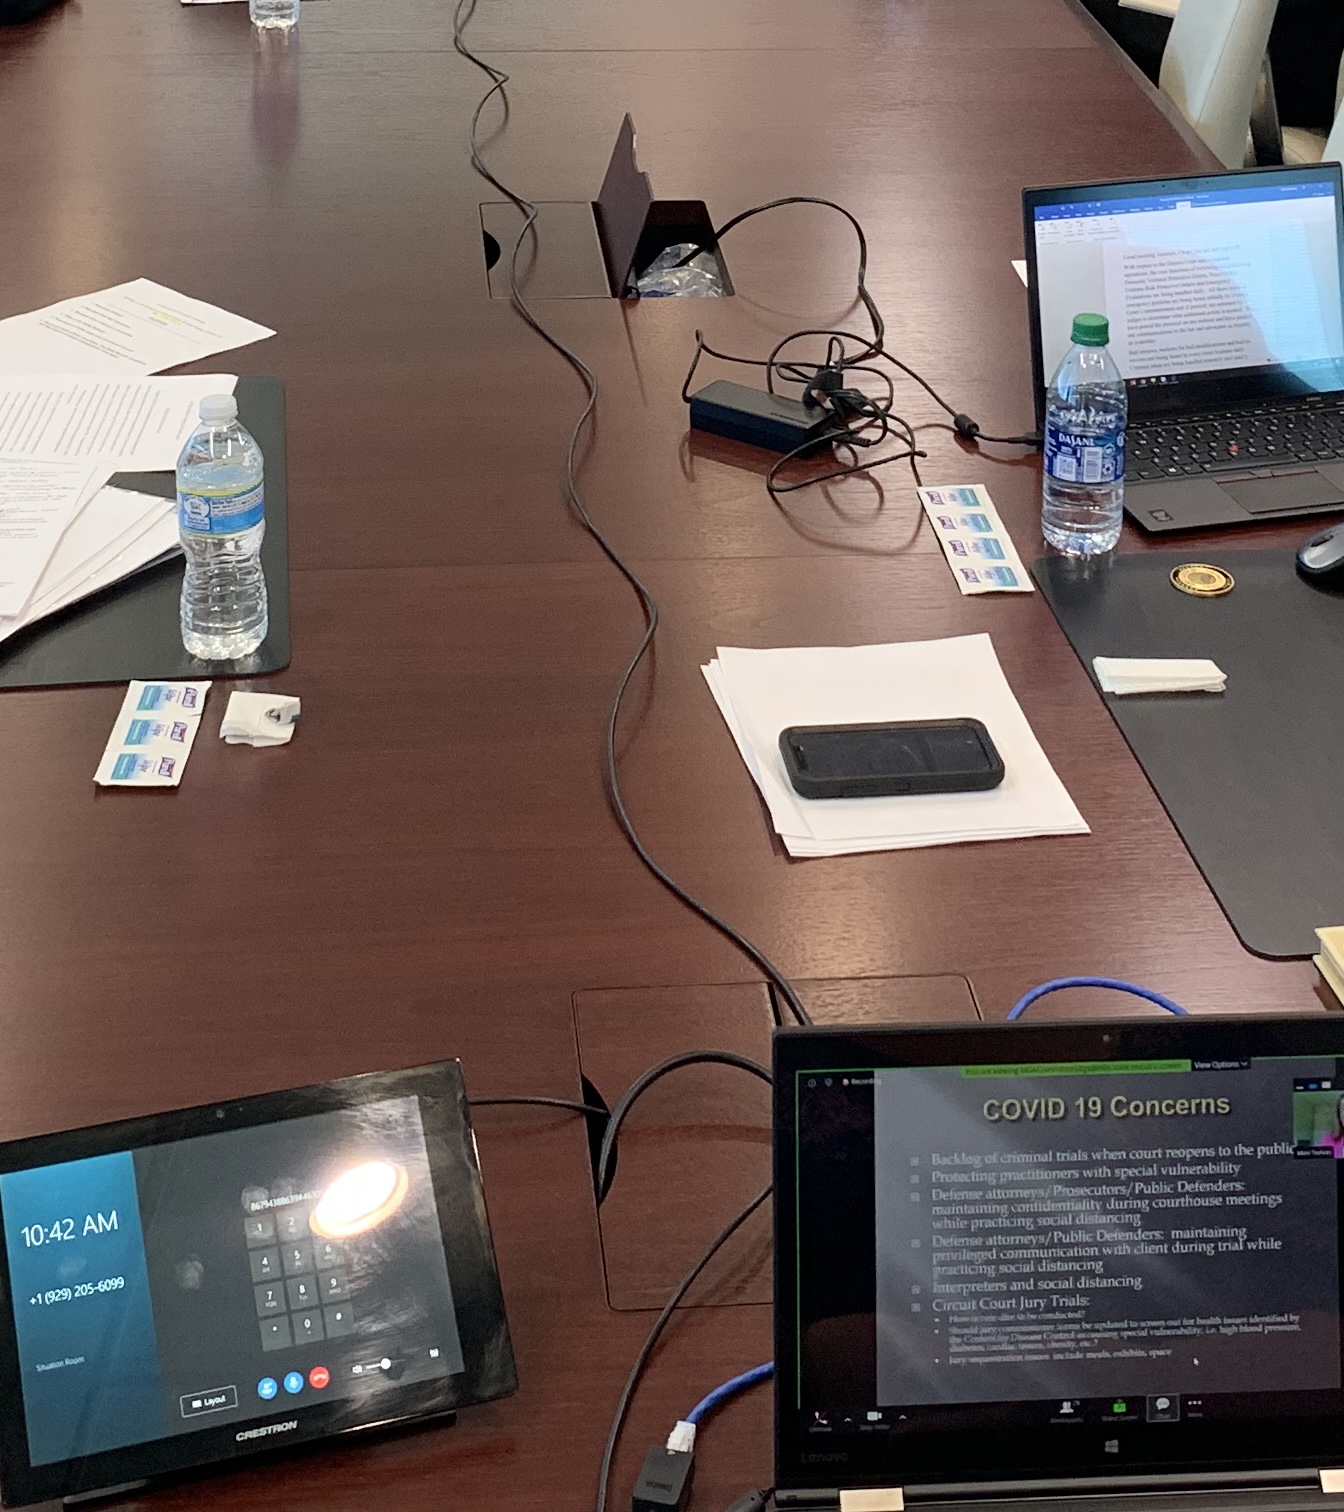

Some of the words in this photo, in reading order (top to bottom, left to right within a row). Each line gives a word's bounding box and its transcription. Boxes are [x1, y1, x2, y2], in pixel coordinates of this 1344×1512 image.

[983, 1097, 1064, 1120] COVID
[1074, 1096, 1101, 1117] 19
[1110, 1092, 1229, 1116] Concerns
[1082, 1166, 1111, 1178] with
[1113, 1165, 1159, 1181] special
[1160, 1162, 1242, 1179] vulnerability
[256, 1222, 263, 1233] 1
[288, 1216, 295, 1227] 2
[21, 1219, 76, 1248] 10:42
[82, 1210, 119, 1238] AM
[294, 1249, 301, 1260] 5
[325, 1243, 332, 1254] 6
[260, 1256, 269, 1266] 4
[330, 1277, 338, 1288] 9
[29, 1293, 42, 1307] +1
[44, 1286, 72, 1306] (929)
[74, 1275, 125, 1297] 205-6099
[298, 1283, 306, 1295] 8
[267, 1290, 274, 1301] 7
[932, 1299, 976, 1311] Circuit
[979, 1297, 1016, 1310] Court
[1019, 1296, 1046, 1312] Jury
[1049, 1295, 1090, 1307] Trials:
[304, 1317, 311, 1329] 0
[203, 1393, 227, 1409] Layout
[236, 1420, 298, 1442] CRESTRON
